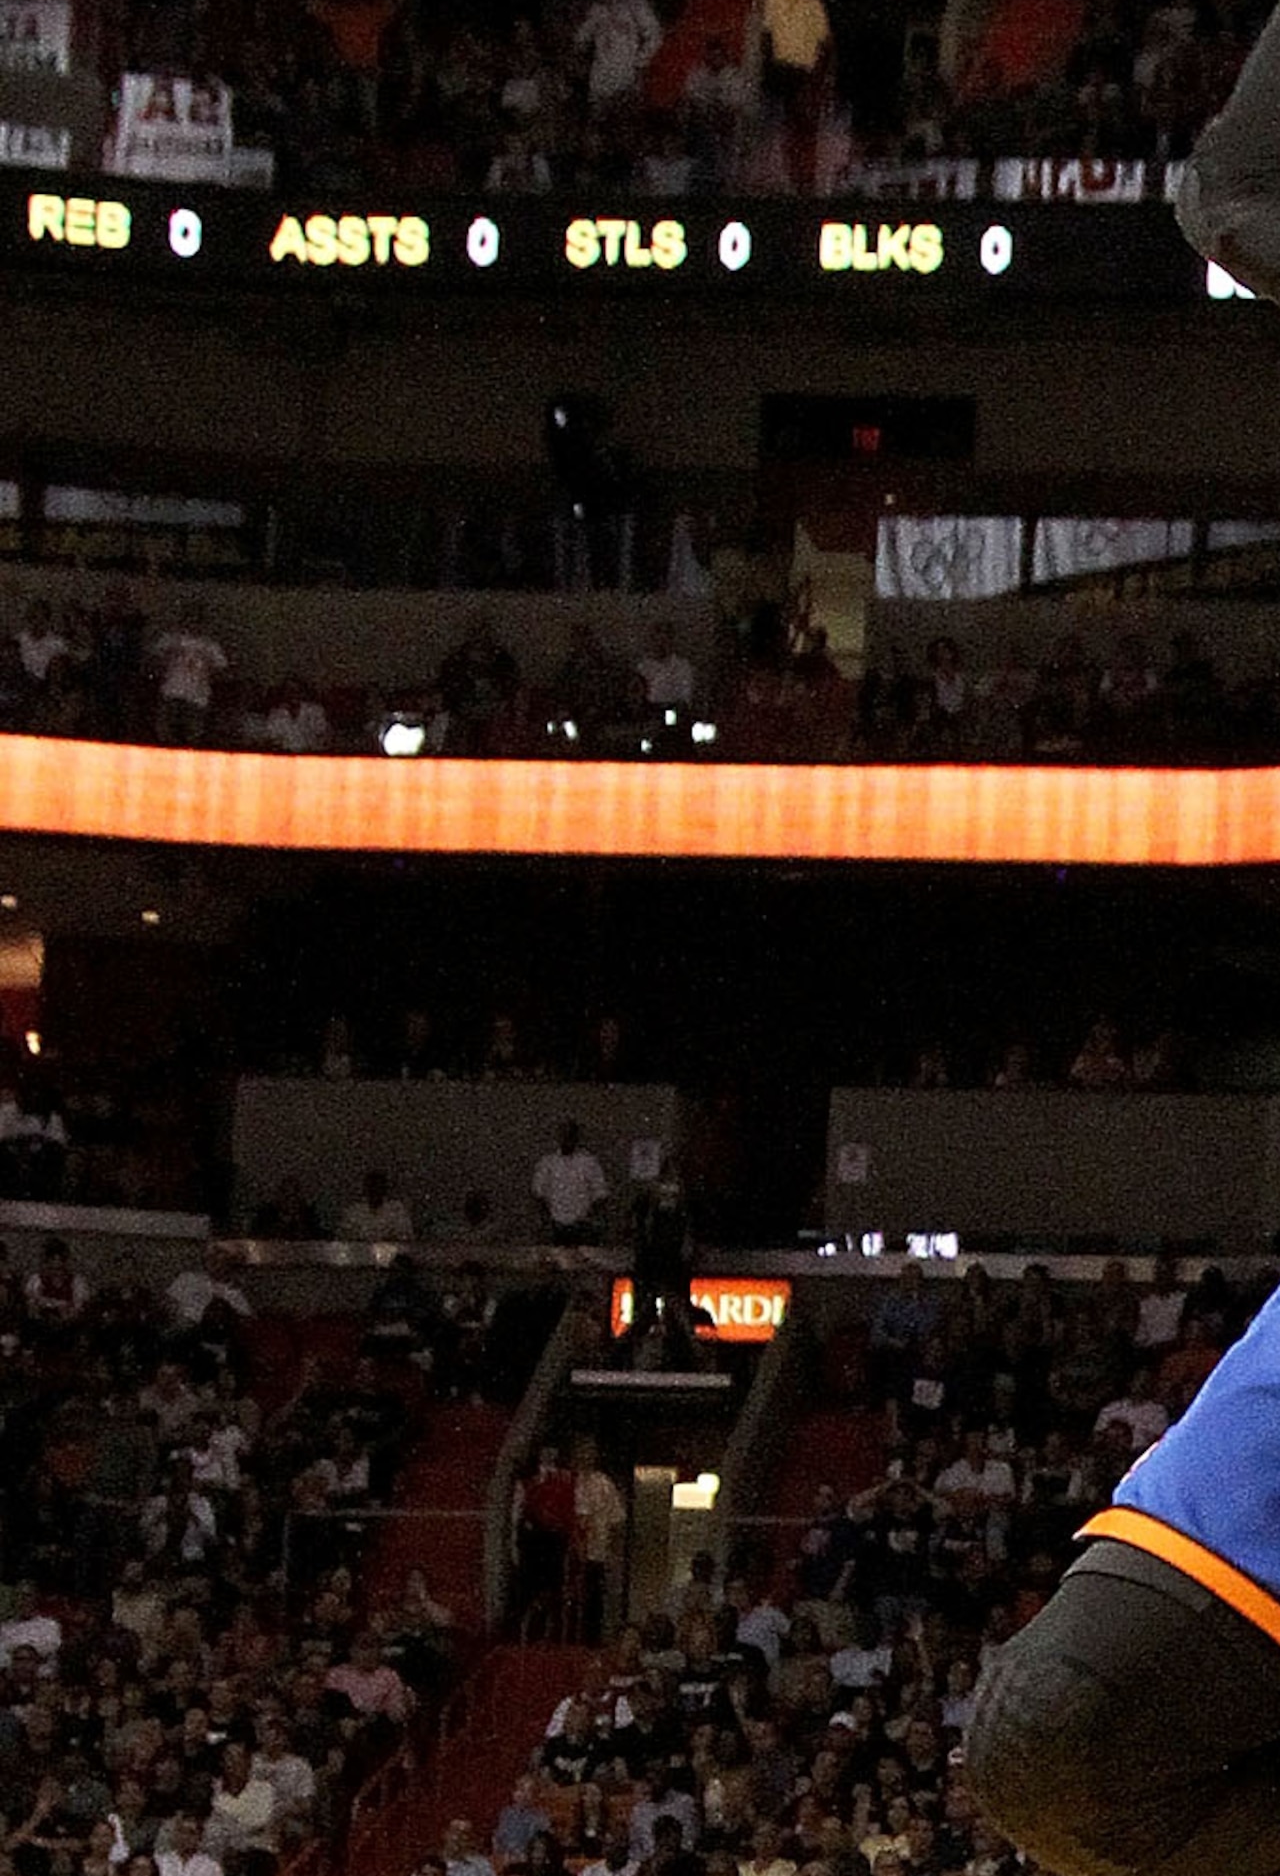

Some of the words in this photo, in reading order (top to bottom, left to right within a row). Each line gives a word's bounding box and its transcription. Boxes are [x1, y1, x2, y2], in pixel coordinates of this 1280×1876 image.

[27, 193, 132, 249] REB
[168, 209, 202, 258] 0
[269, 215, 431, 267] ASSTS
[466, 216, 500, 267] 0
[565, 219, 688, 270] STLS
[718, 222, 752, 271] 0
[818, 223, 944, 274] BLKS
[980, 224, 1013, 275] 0
